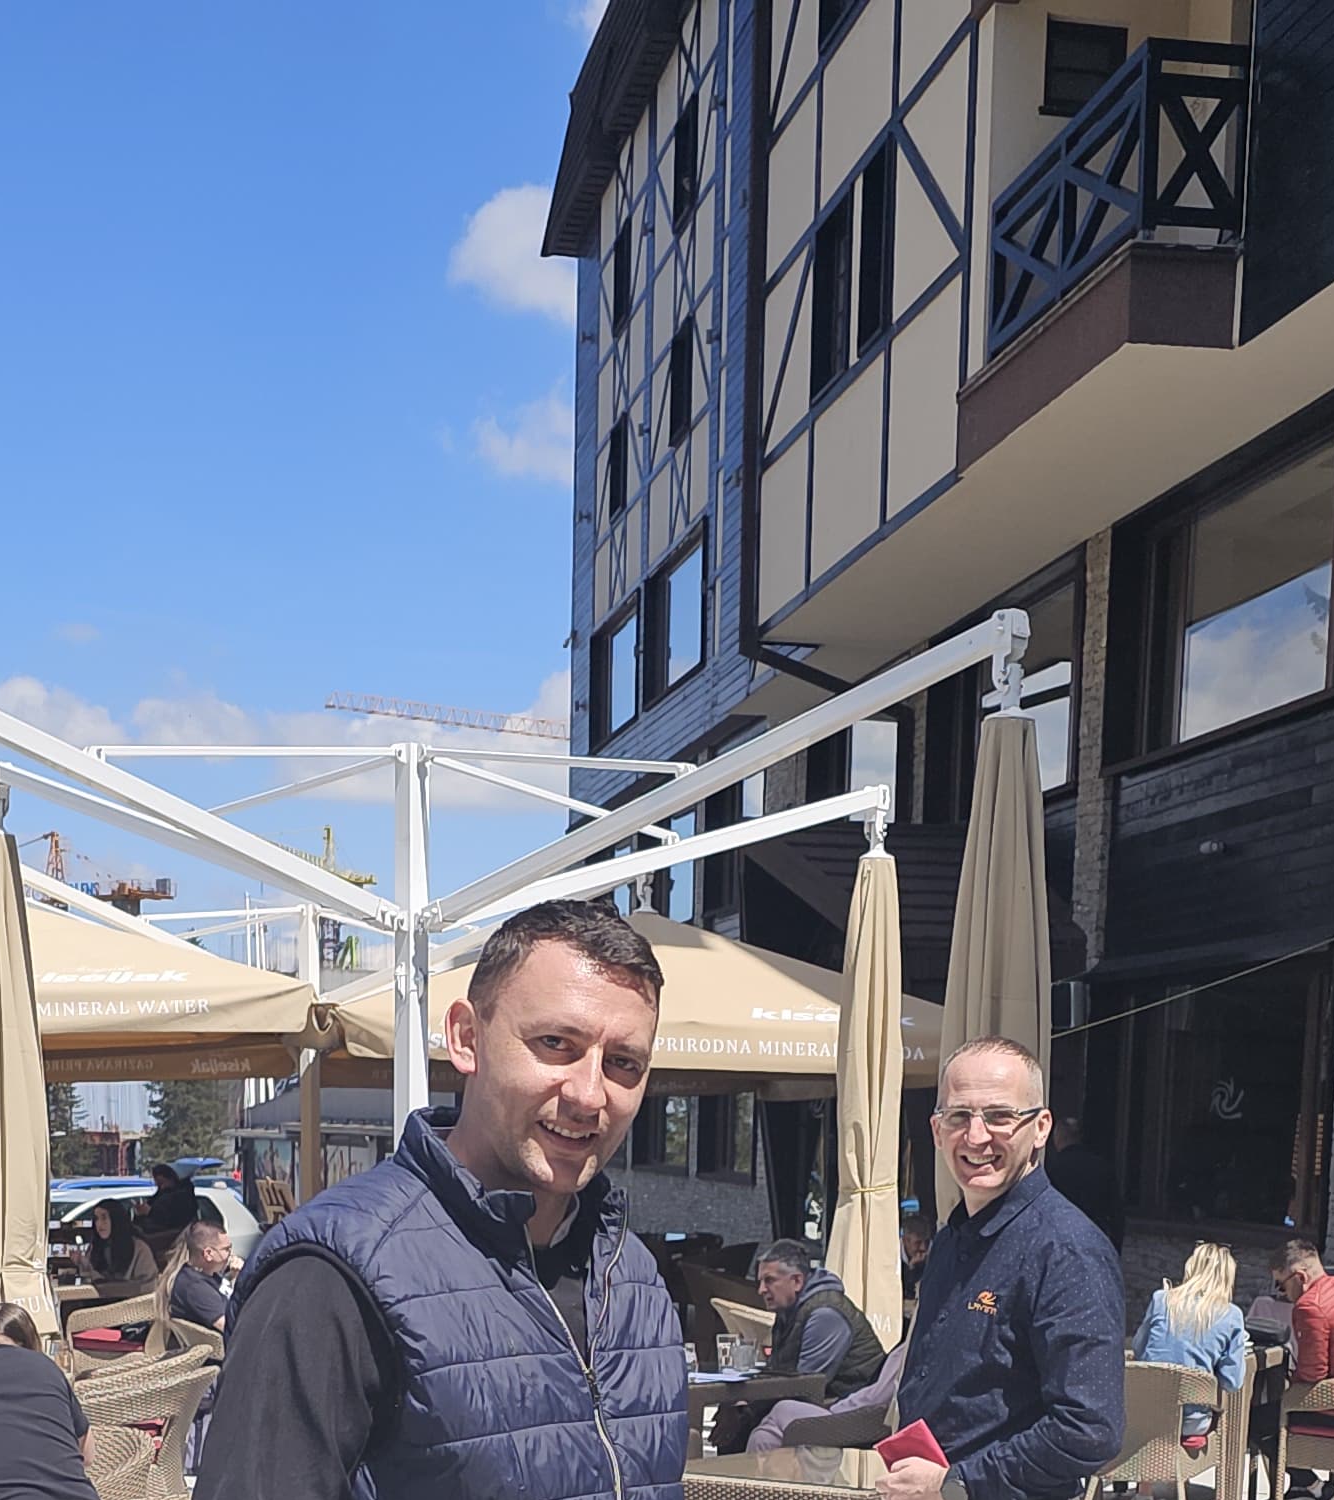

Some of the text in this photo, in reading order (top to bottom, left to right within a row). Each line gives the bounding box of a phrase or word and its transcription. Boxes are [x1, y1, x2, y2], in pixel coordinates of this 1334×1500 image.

[37, 1002, 129, 1017] MINERAL
[137, 999, 210, 1014] WATER
[656, 1037, 751, 1054] PRIRODNA
[759, 1041, 837, 1057] MINERA
